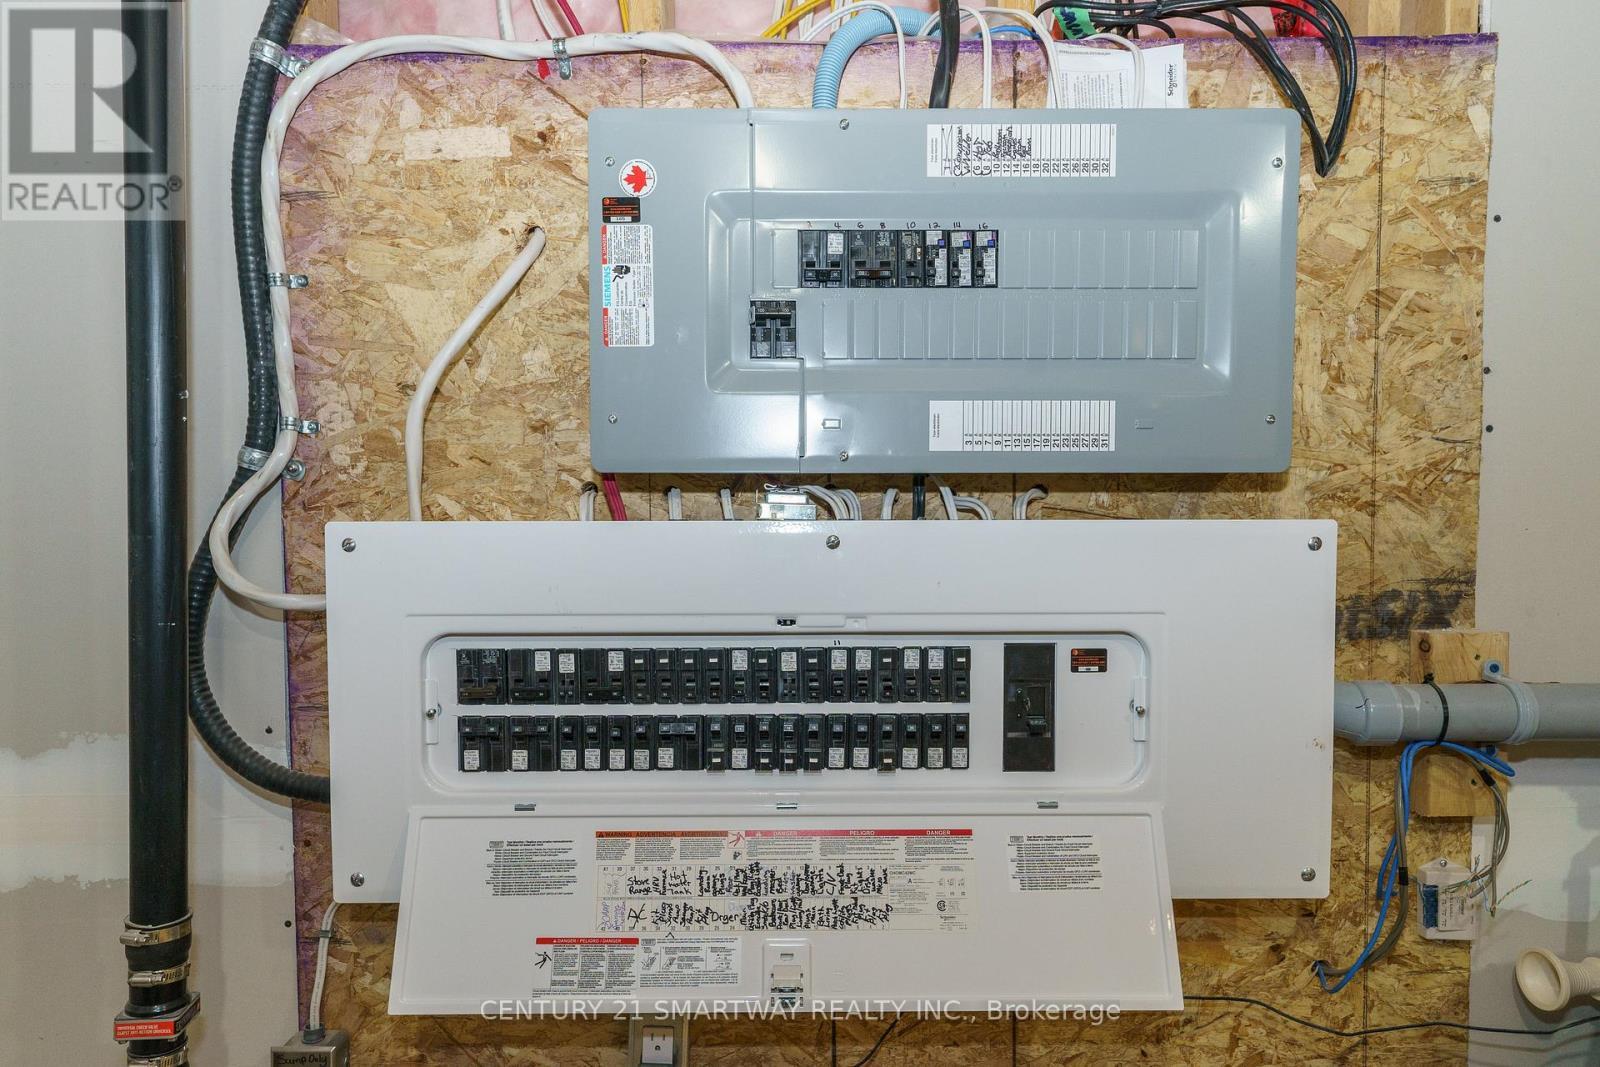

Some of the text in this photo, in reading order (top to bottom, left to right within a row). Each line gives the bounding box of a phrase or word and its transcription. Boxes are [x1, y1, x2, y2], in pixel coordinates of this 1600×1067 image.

[993, 164, 1000, 173] 10
[1003, 164, 1010, 173] 12
[1013, 164, 1020, 173] 14
[1023, 164, 1029, 173] 16
[1033, 163, 1040, 174] 18
[1042, 163, 1050, 174] 20
[1052, 163, 1060, 174] 22
[1062, 163, 1070, 174] 24
[1072, 163, 1079, 174] 26
[1082, 163, 1089, 174] 28
[1092, 163, 1099, 174] 30
[1102, 163, 1109, 174] 32
[1004, 439, 1011, 448] 11
[1014, 438, 1021, 448] 13
[1024, 438, 1031, 448] 15
[1034, 438, 1040, 448] 17
[1044, 438, 1050, 448] 19
[1053, 438, 1060, 448] 21
[1063, 438, 1070, 448] 23
[1073, 438, 1079, 448] 25
[1083, 438, 1089, 448] 27
[1092, 438, 1099, 448] 29
[1102, 438, 1109, 448] 31
